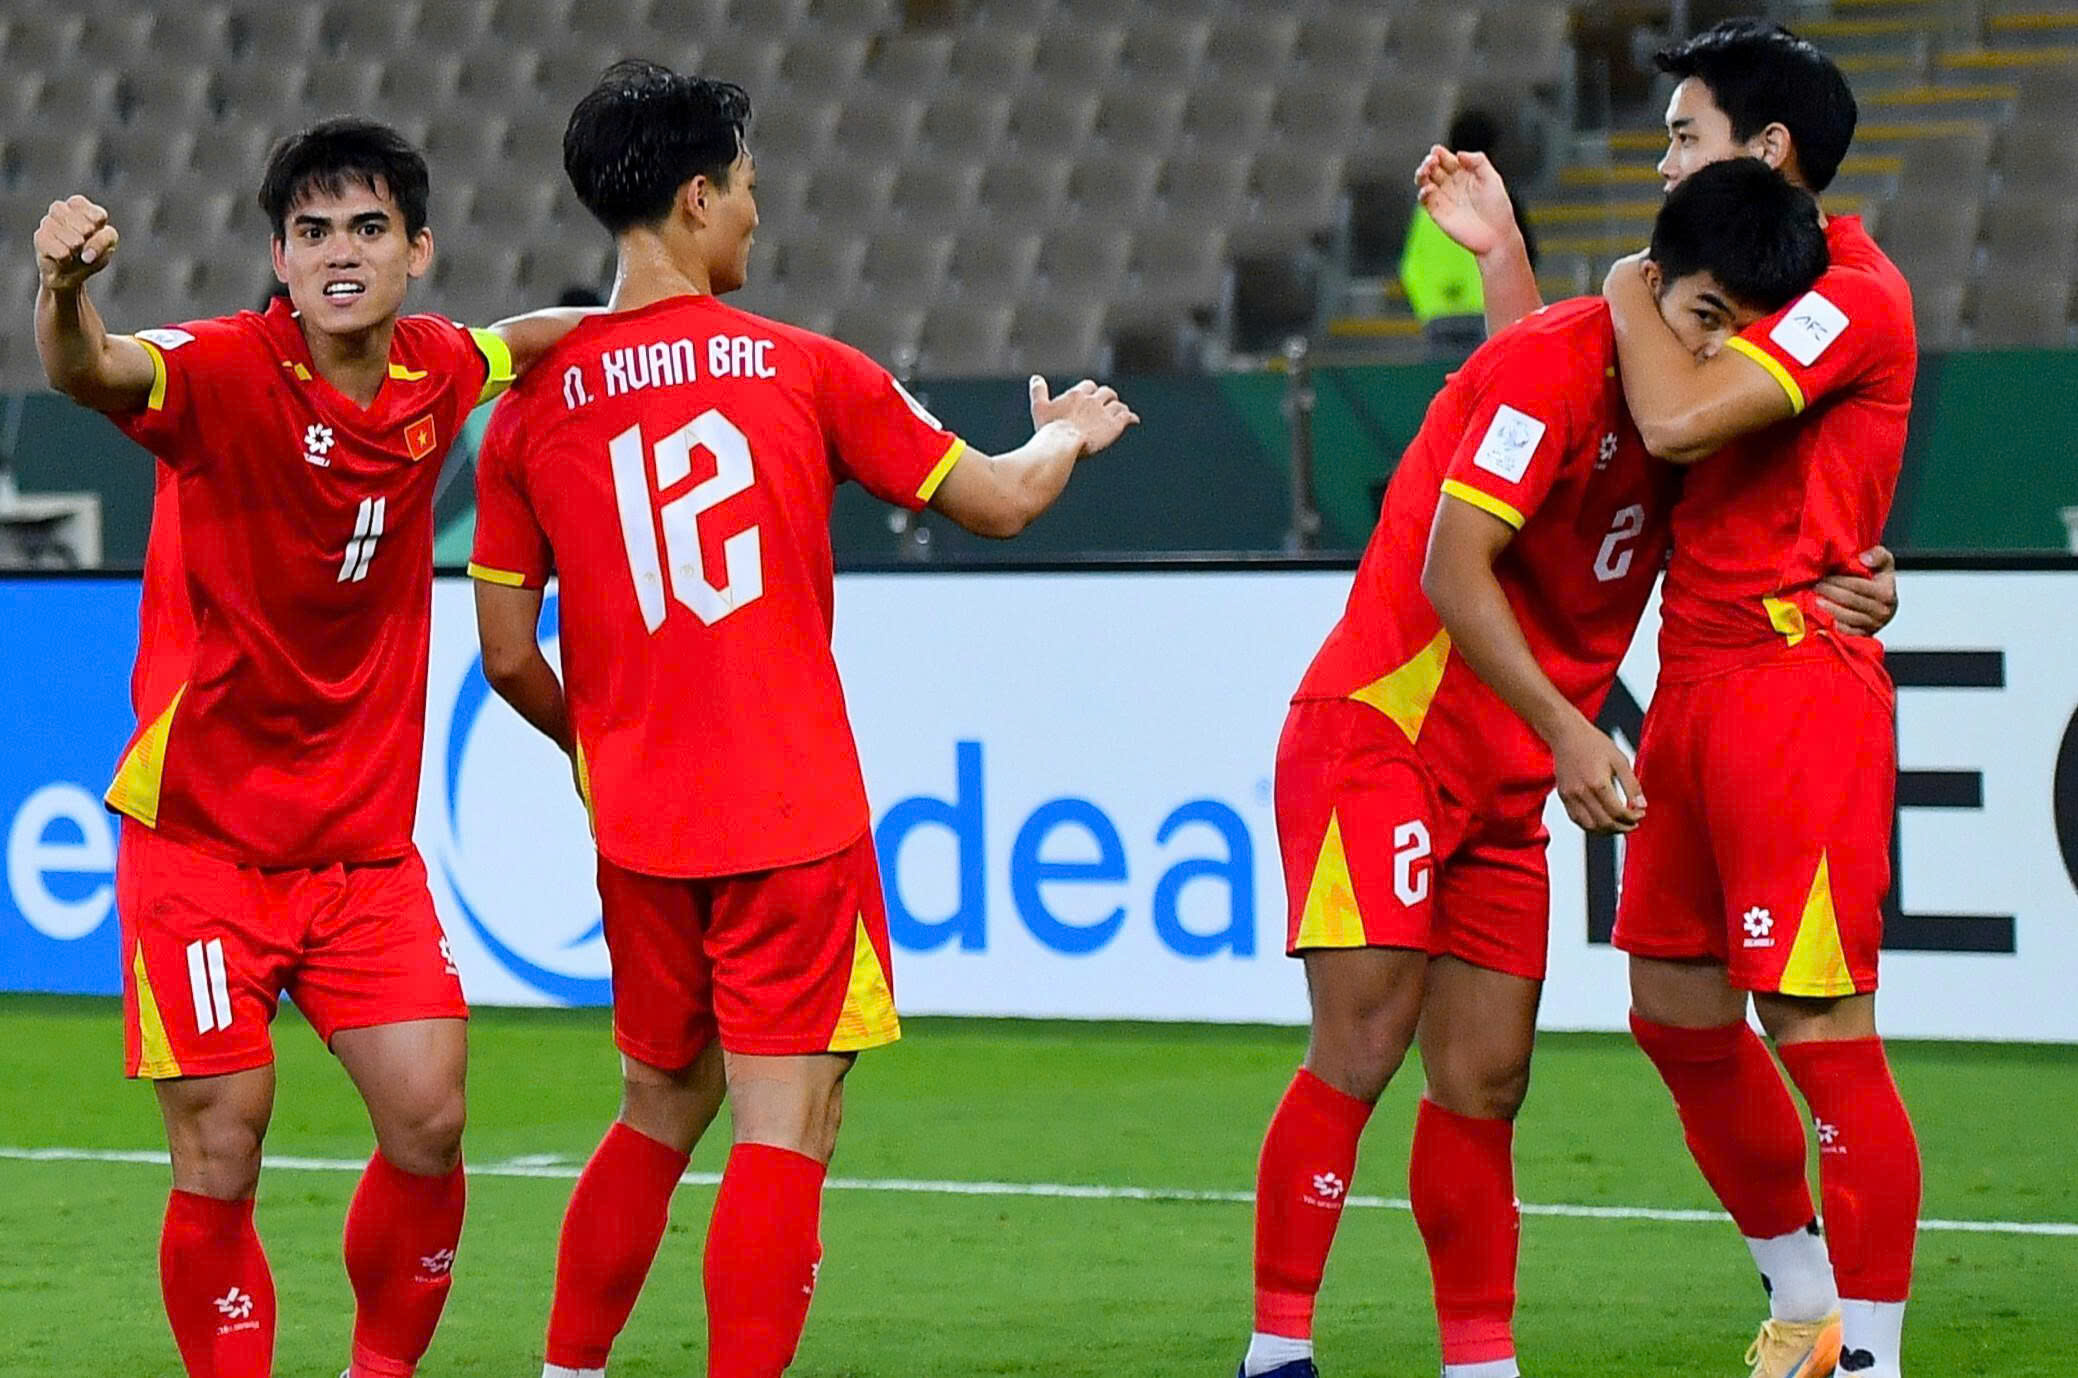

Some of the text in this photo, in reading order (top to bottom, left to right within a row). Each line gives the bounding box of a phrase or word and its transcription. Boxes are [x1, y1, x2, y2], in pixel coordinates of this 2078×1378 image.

[601, 338, 698, 397] XUAN
[708, 333, 777, 380] BAC
[1793, 315, 1829, 342] AFC
[336, 495, 386, 584] 11
[608, 407, 765, 637] 12
[1593, 503, 1646, 582] 2
[874, 740, 1255, 960] dea
[1393, 818, 1431, 908] 2
[186, 938, 233, 1036] 11
